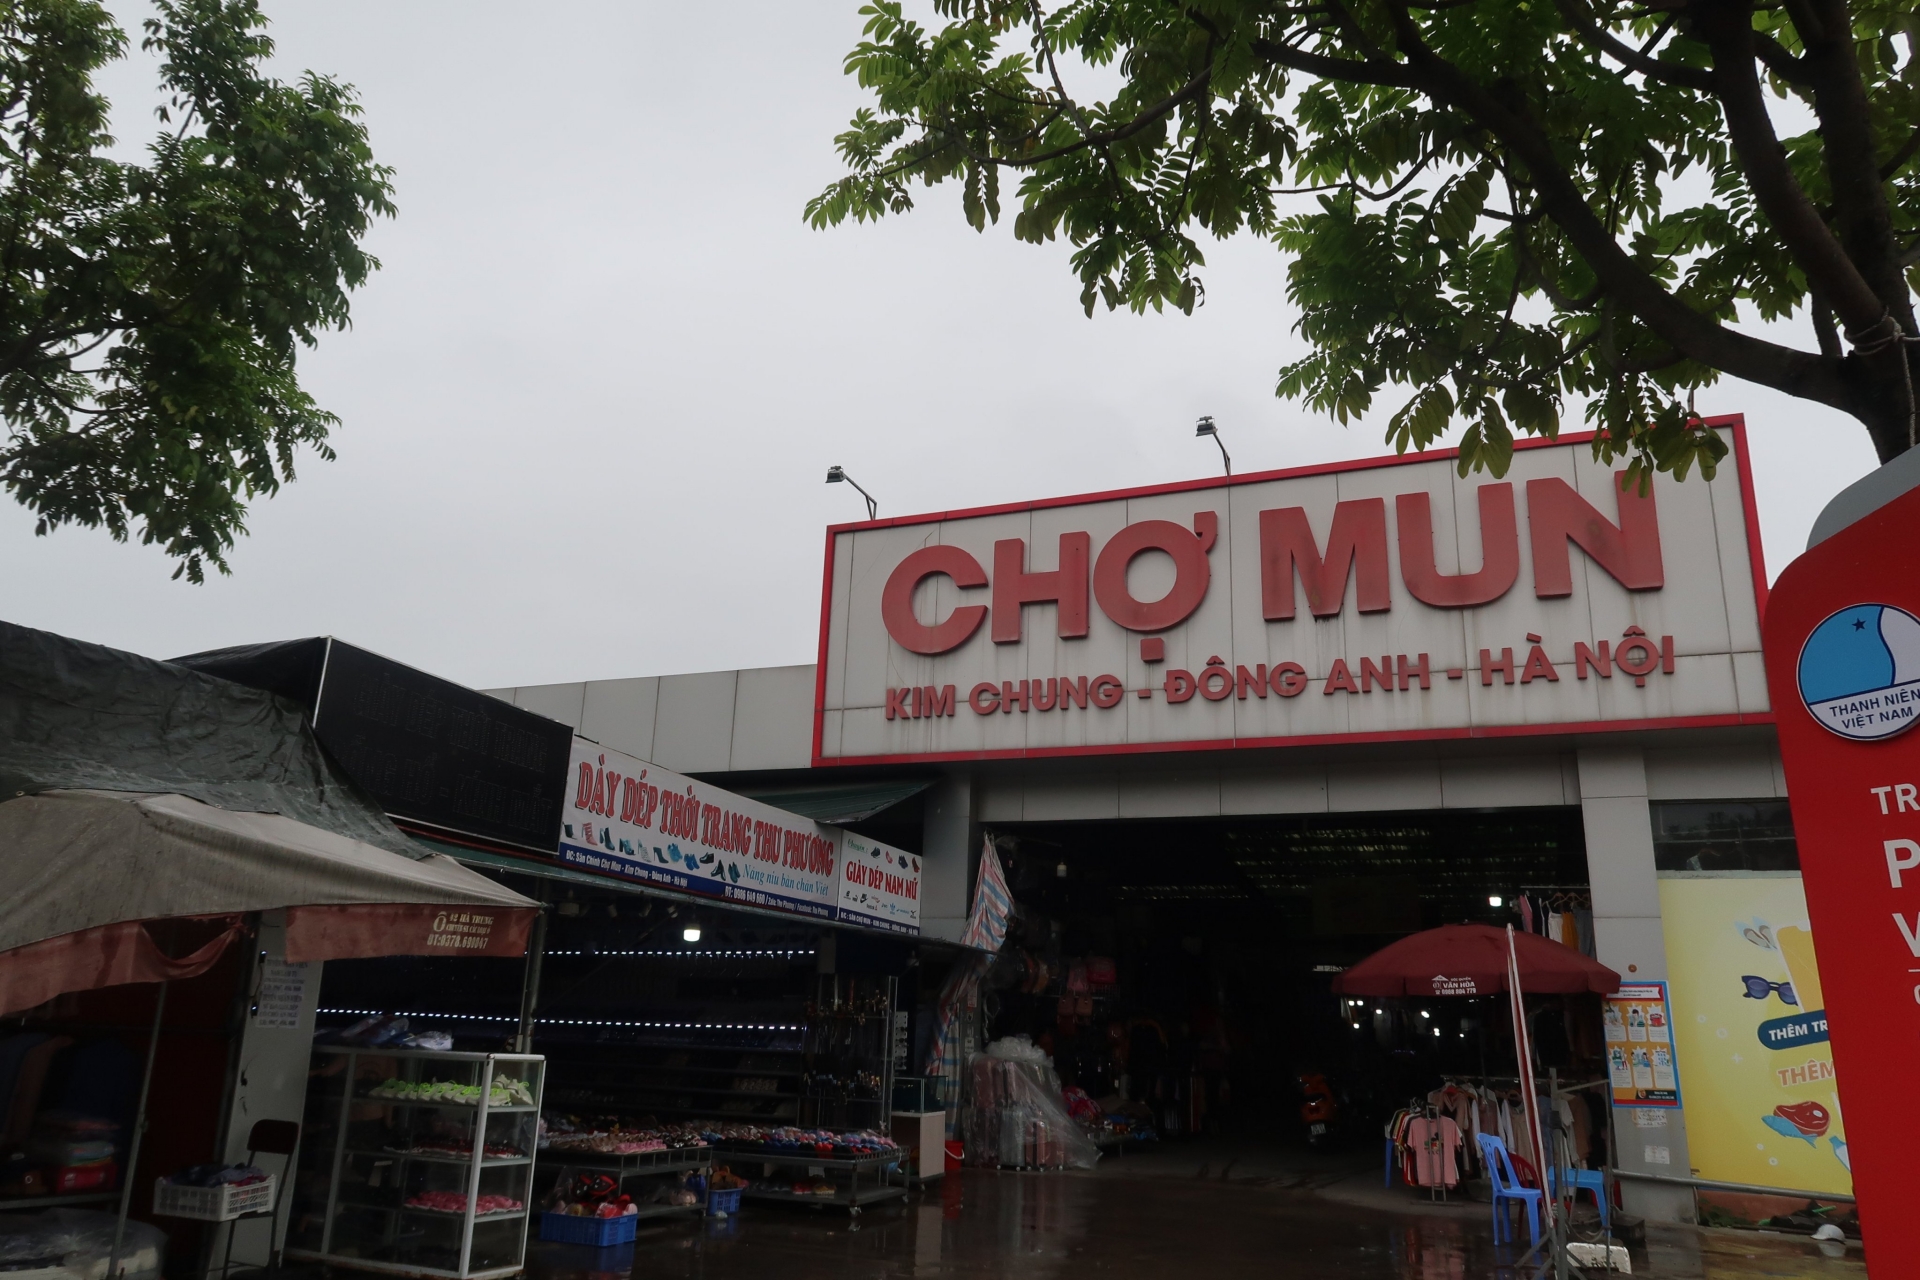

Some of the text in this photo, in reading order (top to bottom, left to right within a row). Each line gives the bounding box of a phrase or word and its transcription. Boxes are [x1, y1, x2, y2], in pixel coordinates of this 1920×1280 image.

[881, 470, 1664, 662] CHỢ MUN
[885, 685, 956, 720] KIM
[969, 673, 1124, 716] CHUNG
[1164, 655, 1307, 705] ĐÔNG
[1323, 652, 1431, 695] ANH
[1480, 633, 1560, 685] HÀ
[1575, 626, 1674, 688] NỘI
[1829, 689, 1920, 717] THANH NIÊN
[1841, 706, 1914, 729] VIỆT NAM
[621, 769, 658, 829] DÉP
[660, 785, 700, 842] THỜI
[701, 803, 752, 856] TRANG
[754, 820, 783, 864] THU
[782, 829, 834, 877] PHƯƠNG
[611, 861, 622, 872] Mun
[625, 864, 634, 875] Kim
[634, 866, 648, 879] Chung
[846, 859, 918, 900] GIÀY DÉP NAM NỮ
[766, 871, 779, 885] niu
[781, 873, 794, 889] bàn
[815, 880, 829, 898] Việt
[433, 911, 447, 932] Ô
[1769, 1022, 1808, 1042] THÊM
[1777, 1059, 1835, 1087] THÊM
